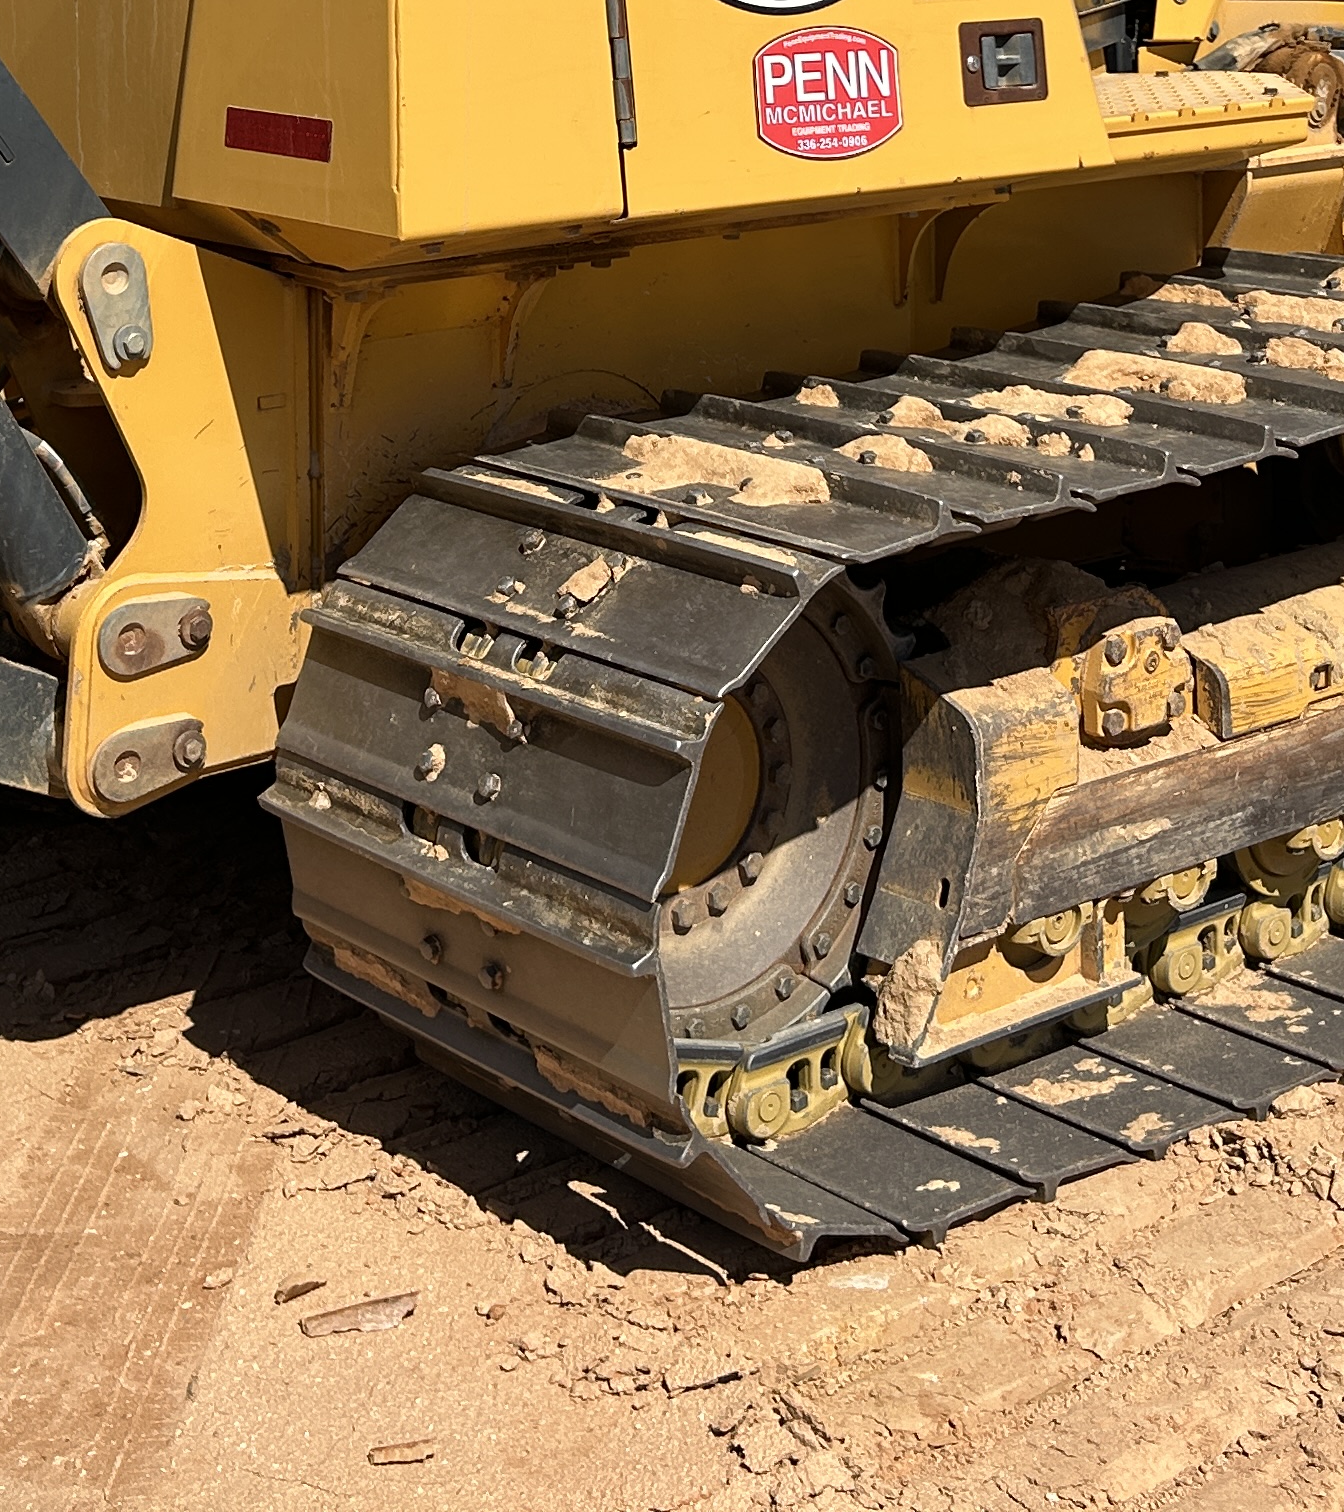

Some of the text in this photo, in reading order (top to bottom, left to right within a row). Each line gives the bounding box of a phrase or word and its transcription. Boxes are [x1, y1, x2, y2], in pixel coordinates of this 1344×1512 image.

[762, 49, 891, 104] PENN
[765, 100, 894, 125] MCMICHAEL
[792, 122, 871, 136] EQUIPMENT TRADING
[797, 135, 868, 150] 336-254-0906
